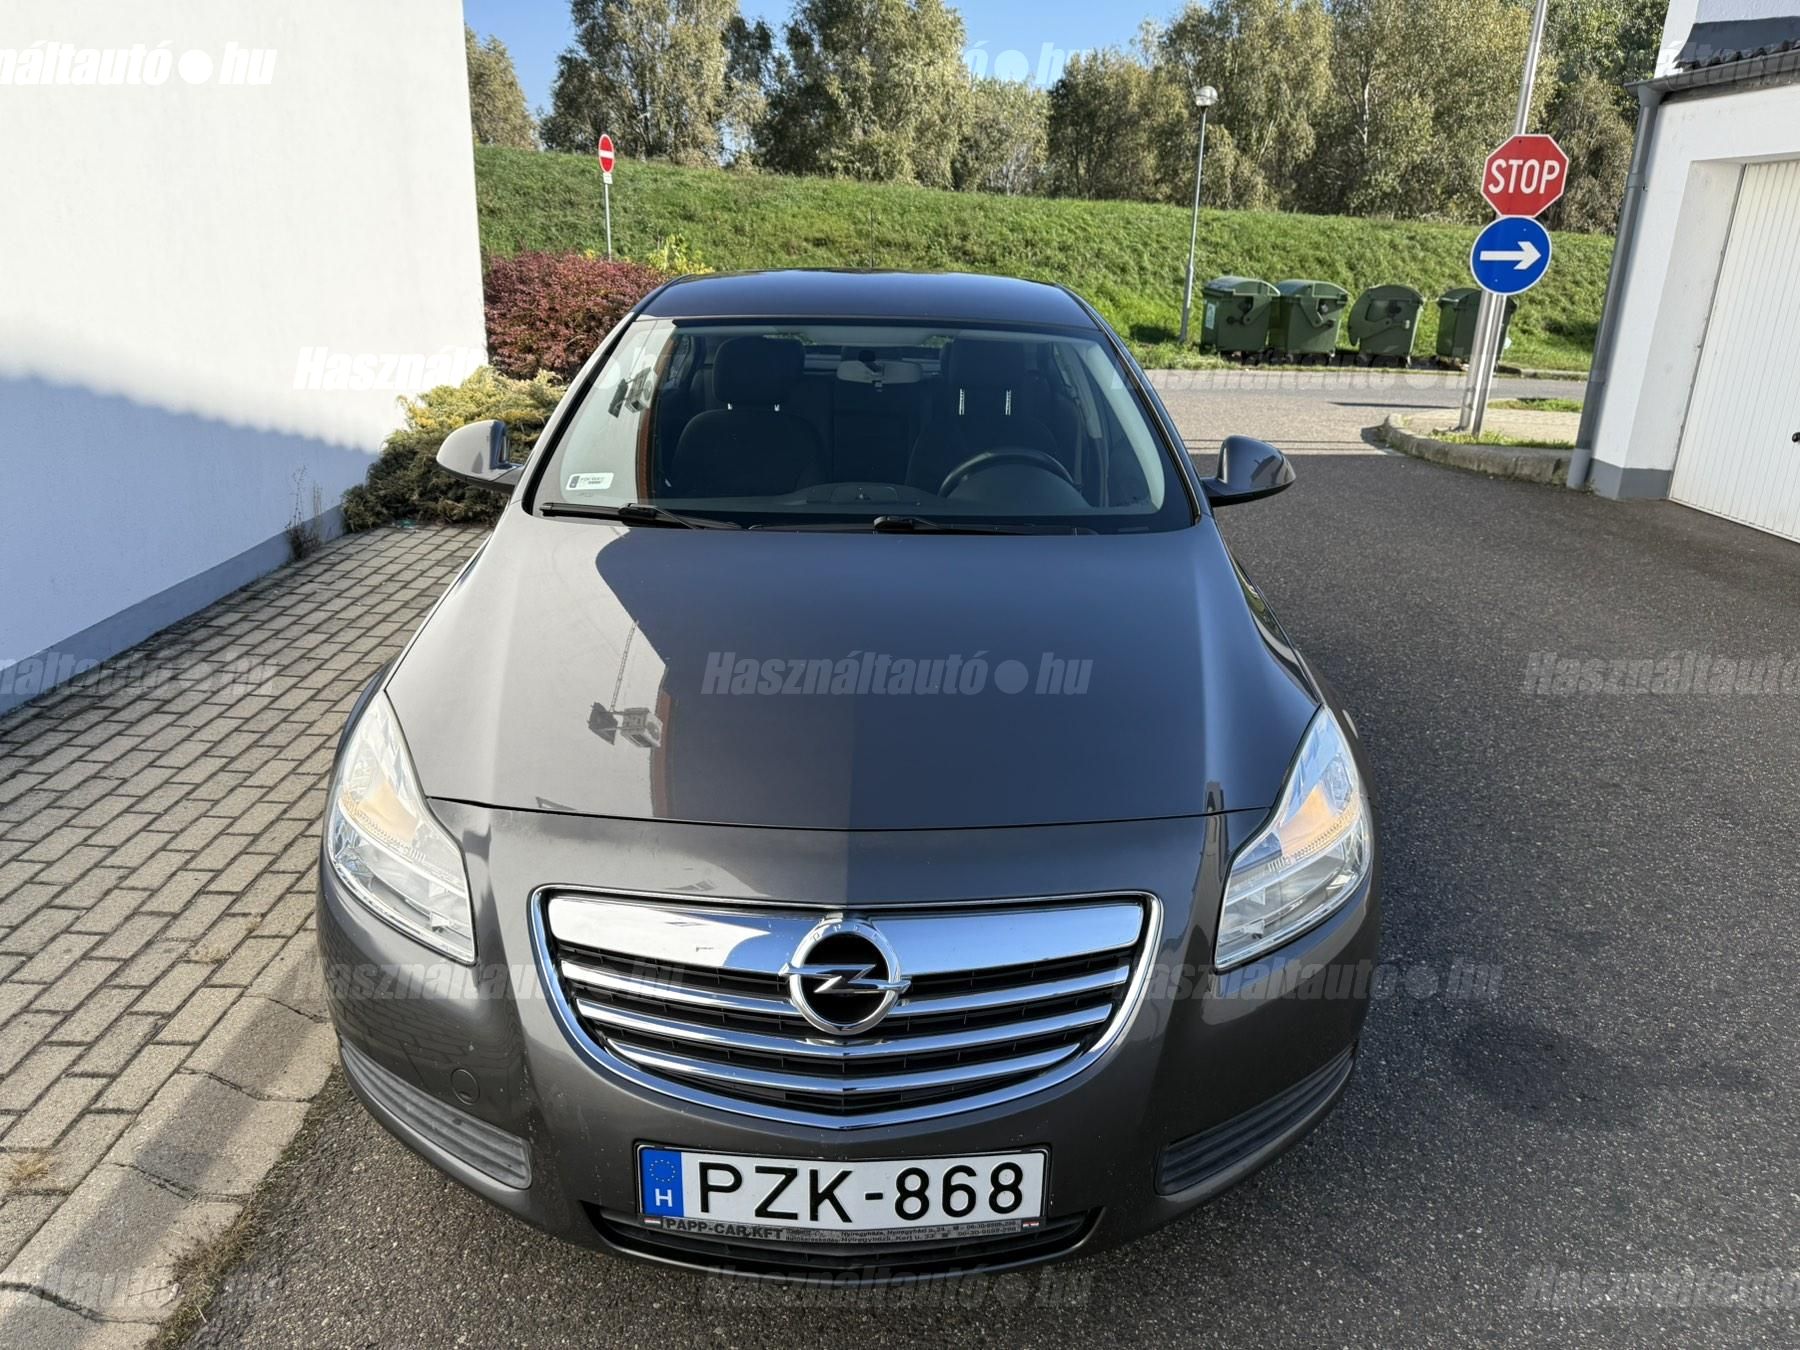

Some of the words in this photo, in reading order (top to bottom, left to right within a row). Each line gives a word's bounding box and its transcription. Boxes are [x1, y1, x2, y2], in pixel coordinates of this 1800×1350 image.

[1488, 158, 1561, 194] STOP
[655, 1188, 673, 1207] H
[699, 1161, 1024, 1223] PZK-868
